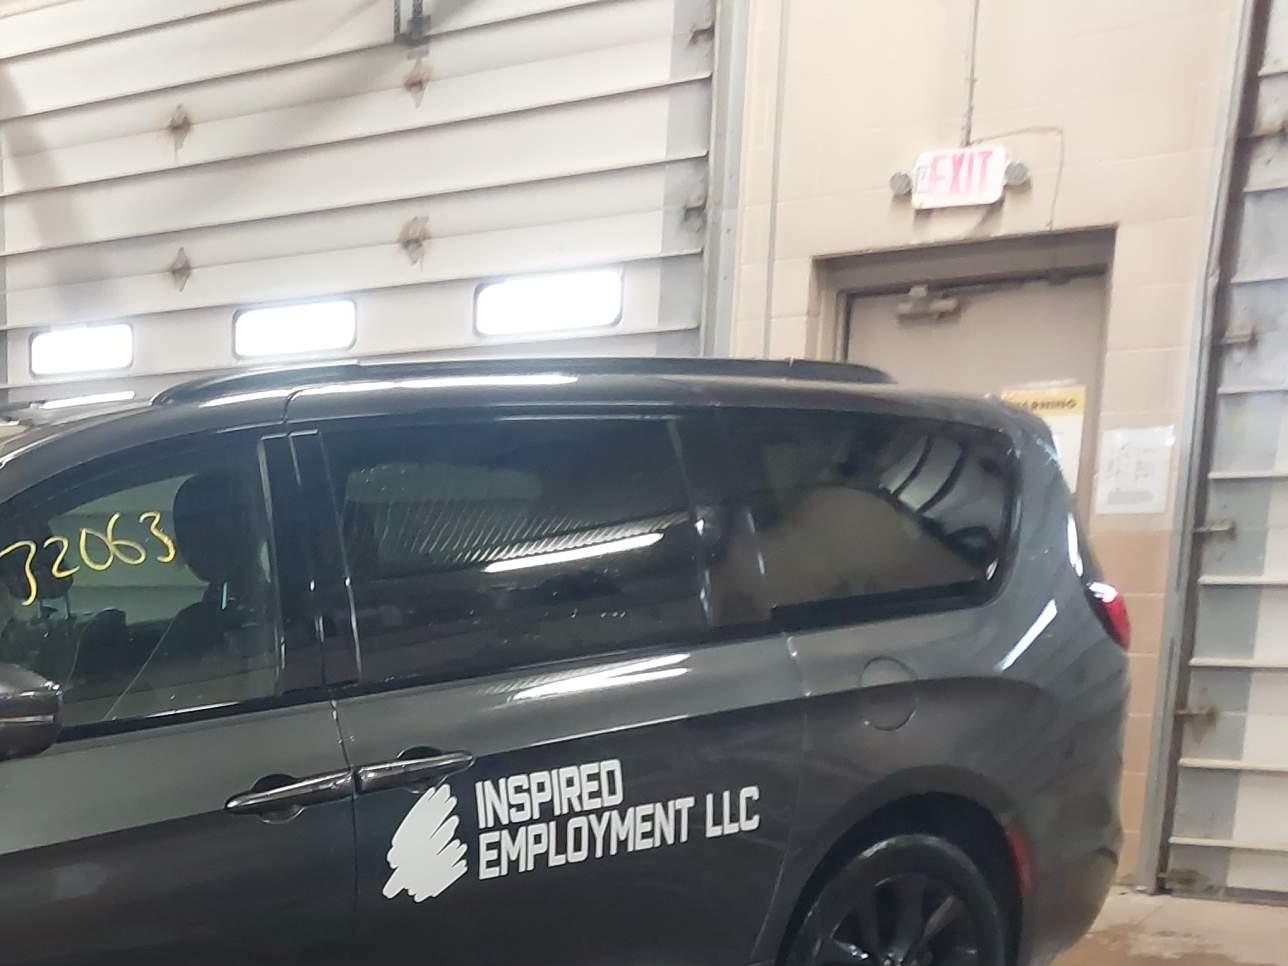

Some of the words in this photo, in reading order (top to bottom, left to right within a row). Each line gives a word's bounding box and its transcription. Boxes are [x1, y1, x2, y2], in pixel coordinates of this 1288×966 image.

[929, 150, 994, 197] EXIT
[475, 759, 624, 829] INSPIRED
[478, 797, 695, 880] EMPLOYMENT
[704, 785, 761, 839] LLC
